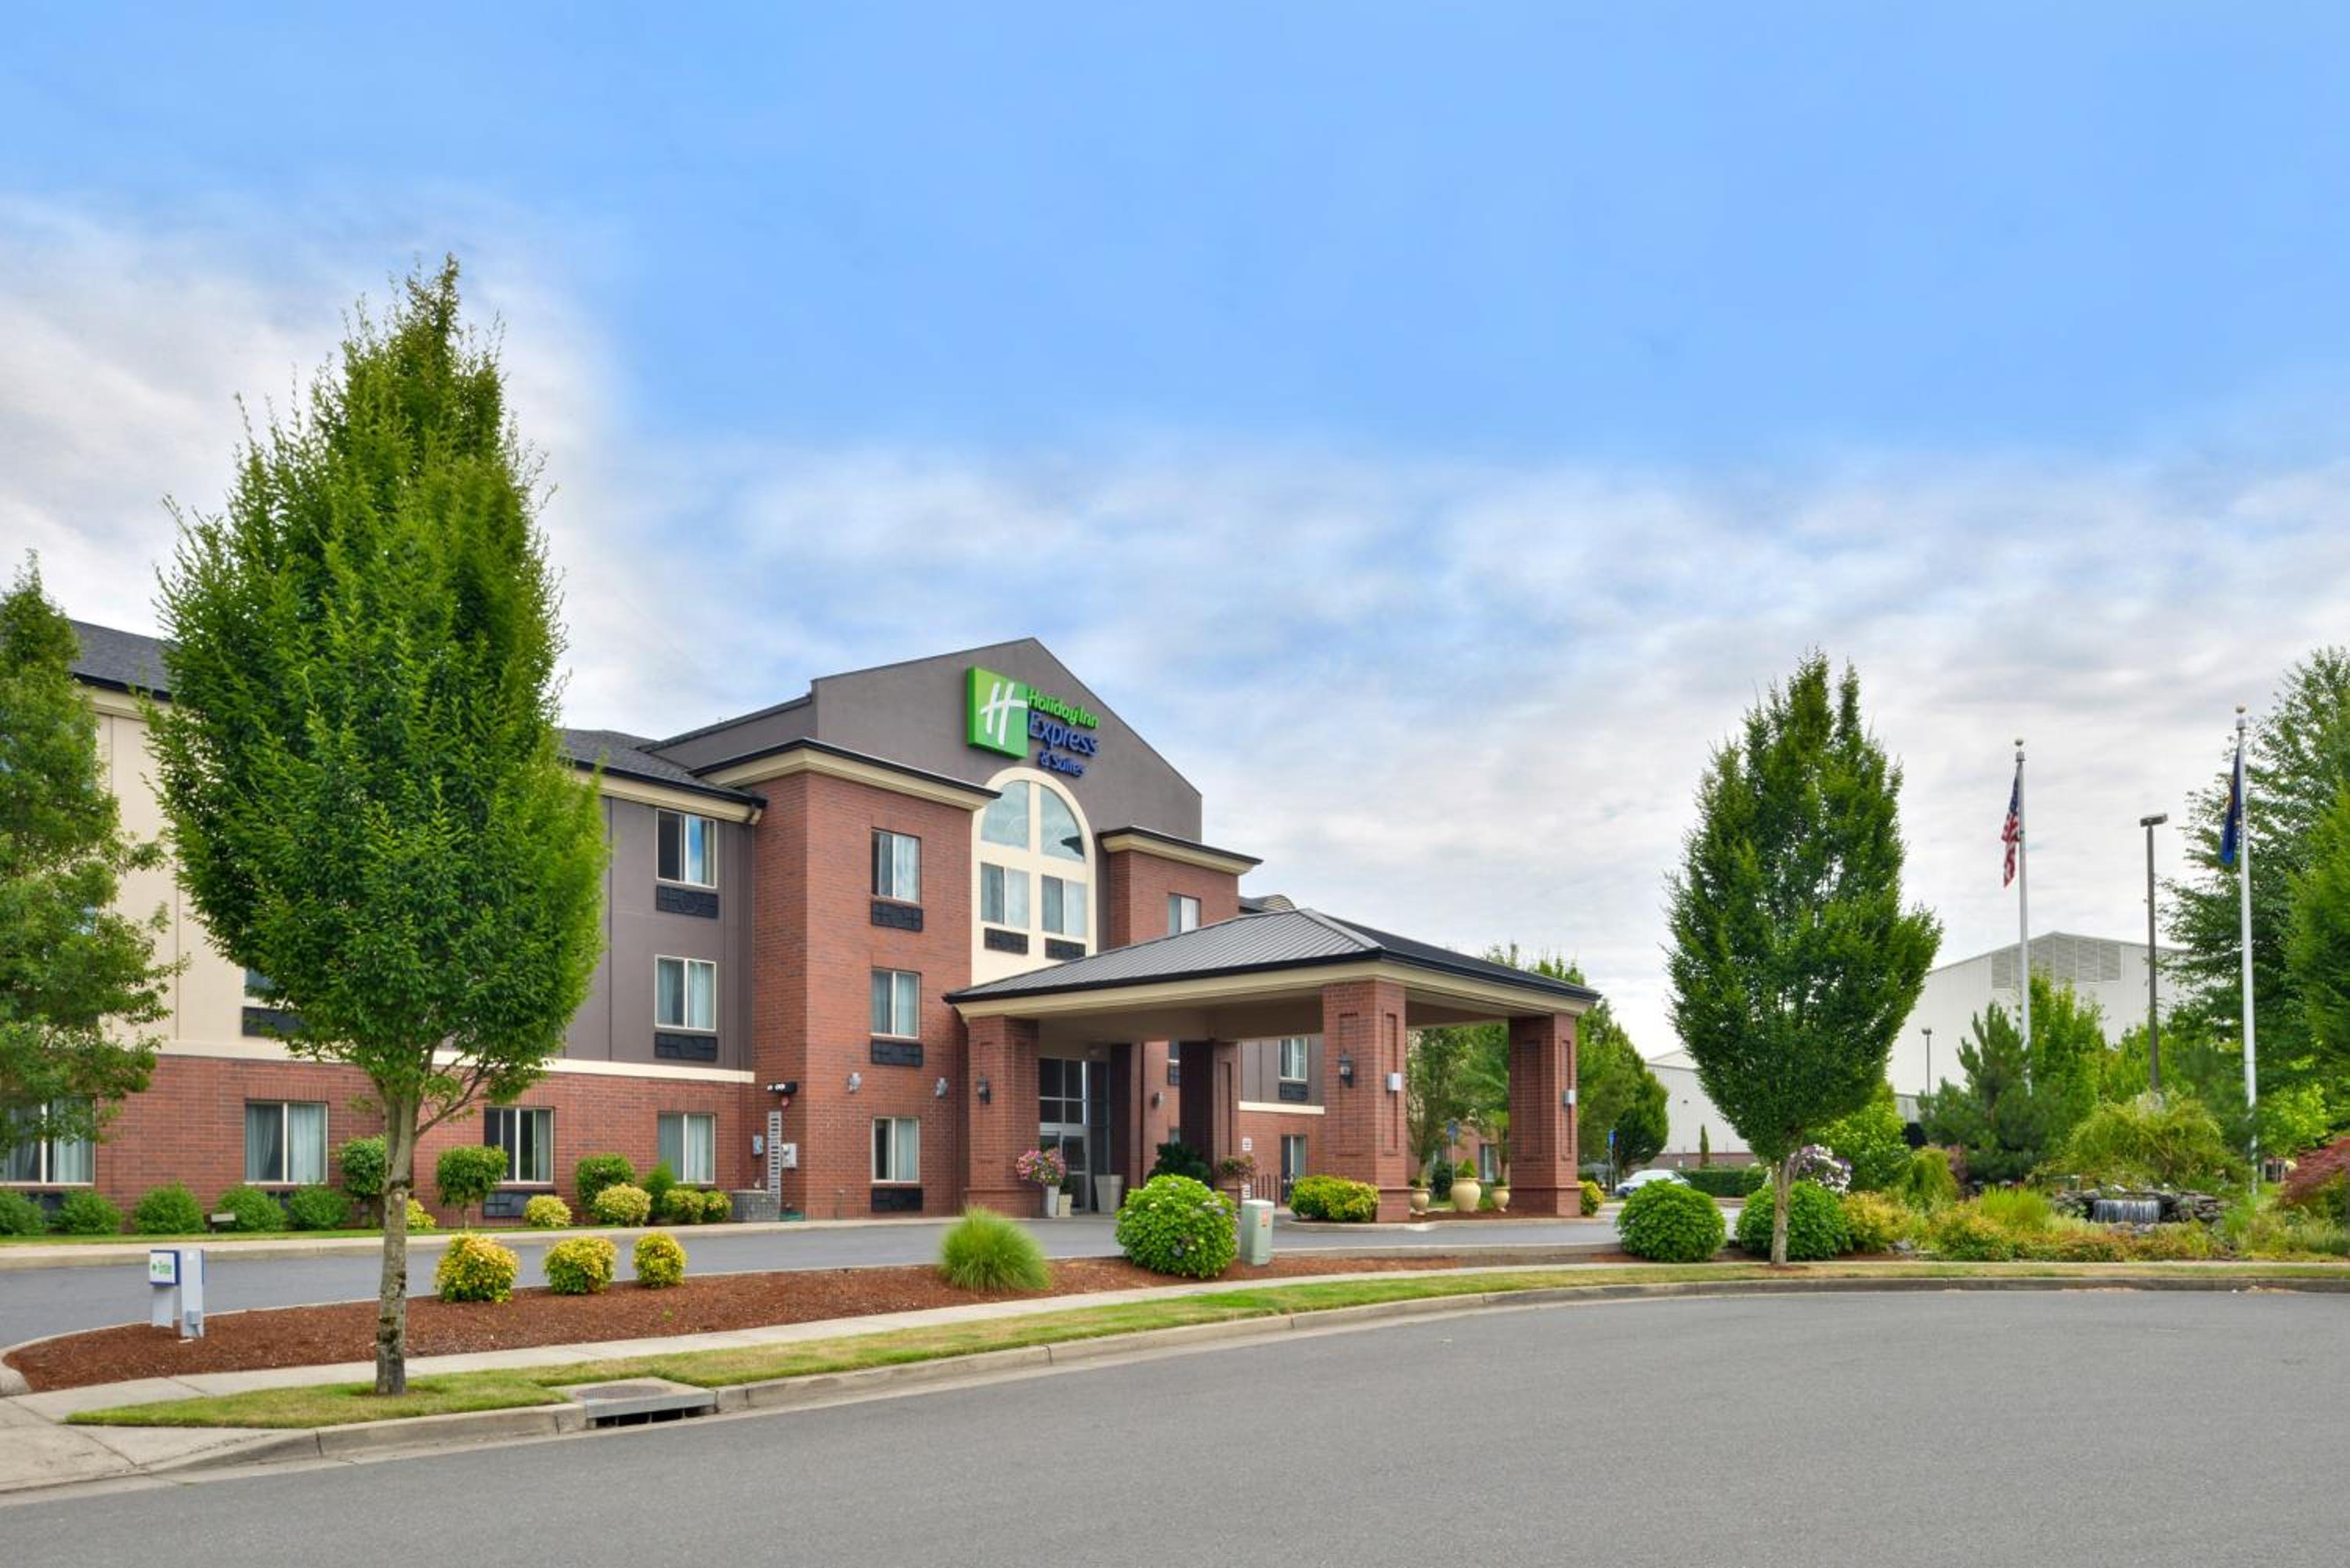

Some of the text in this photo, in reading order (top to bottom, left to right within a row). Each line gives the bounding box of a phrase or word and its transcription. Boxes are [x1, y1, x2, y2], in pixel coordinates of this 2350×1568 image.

[1028, 689, 1099, 728] Holiday Inn
[1029, 710, 1100, 757] Express
[1039, 750, 1050, 766] &
